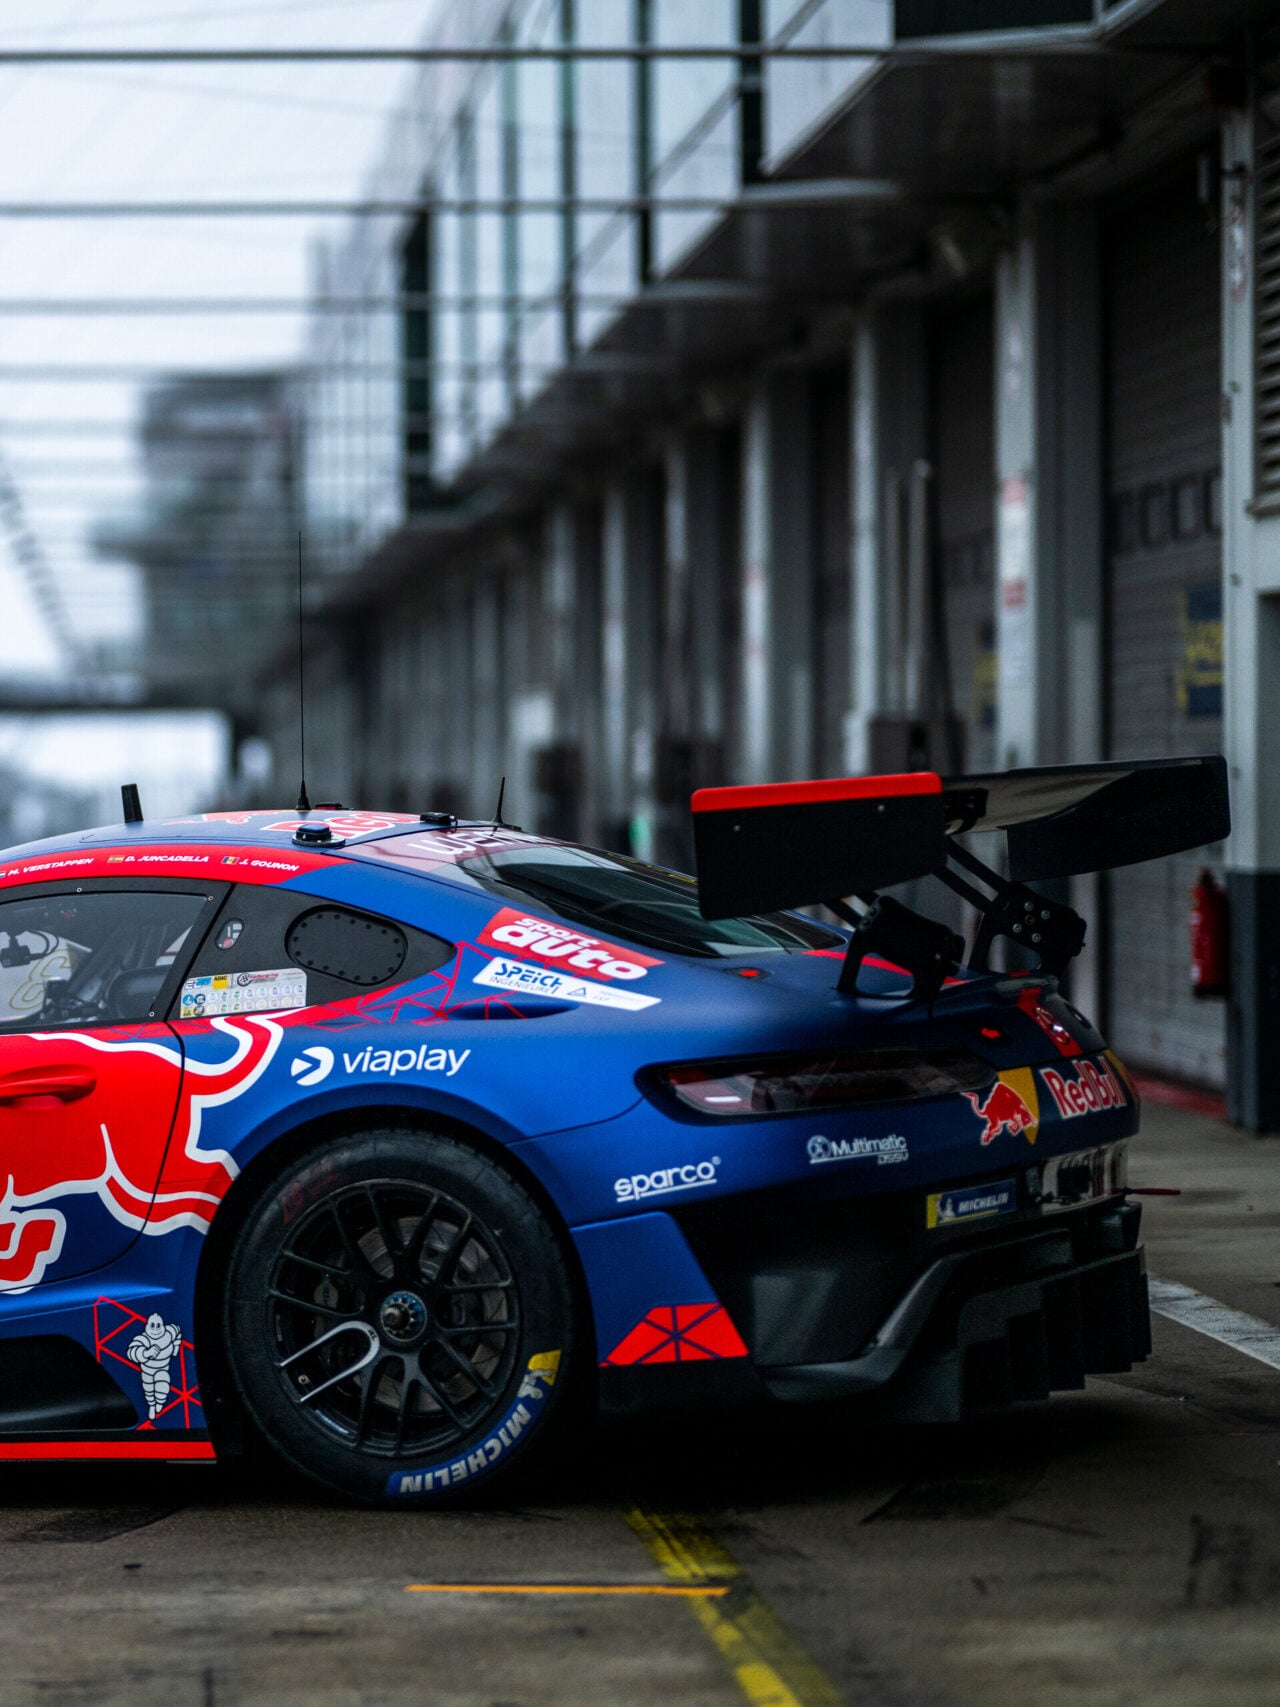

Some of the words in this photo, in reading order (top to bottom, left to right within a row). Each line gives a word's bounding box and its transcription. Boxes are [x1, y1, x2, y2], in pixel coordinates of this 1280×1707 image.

[23, 857, 94, 874] VERSTAPPEN
[124, 855, 136, 863] D.
[137, 855, 210, 863] JUNCADELLA
[251, 860, 299, 871] GOUNON
[514, 917, 600, 947] sport
[491, 924, 648, 980] auto
[342, 1044, 471, 1076] viaplay
[1039, 1059, 1100, 1120] Red
[830, 1133, 908, 1156] Multimatic
[877, 1152, 909, 1165] DSSV
[614, 1161, 716, 1201] sparco
[958, 1191, 1009, 1213] MICHELIN
[399, 1402, 533, 1494] MICHELIN
